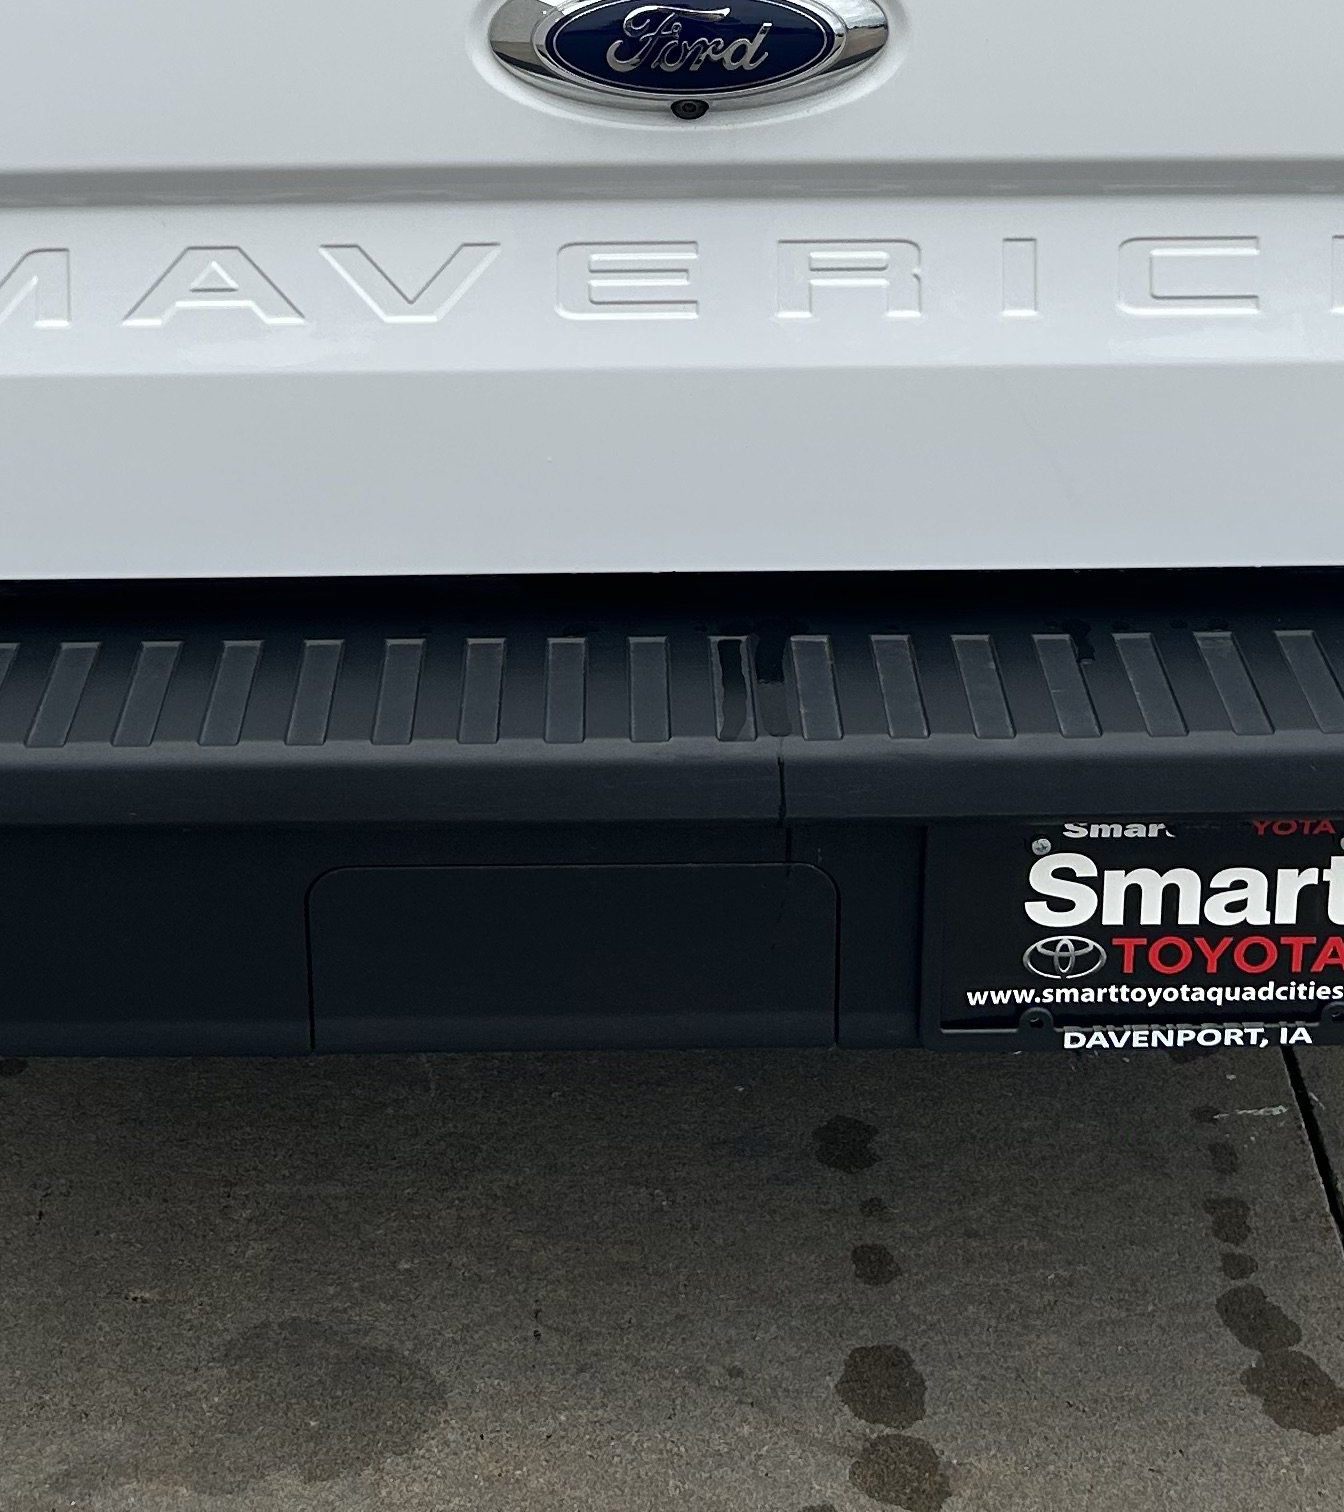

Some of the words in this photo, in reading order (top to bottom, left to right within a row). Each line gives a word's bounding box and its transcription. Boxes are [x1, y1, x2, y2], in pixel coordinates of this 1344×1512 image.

[606, 5, 773, 73] Ford
[1062, 821, 1176, 838] Smar
[1063, 1027, 1270, 1050] DAVENPORT,
[1280, 1027, 1313, 1045] IA
